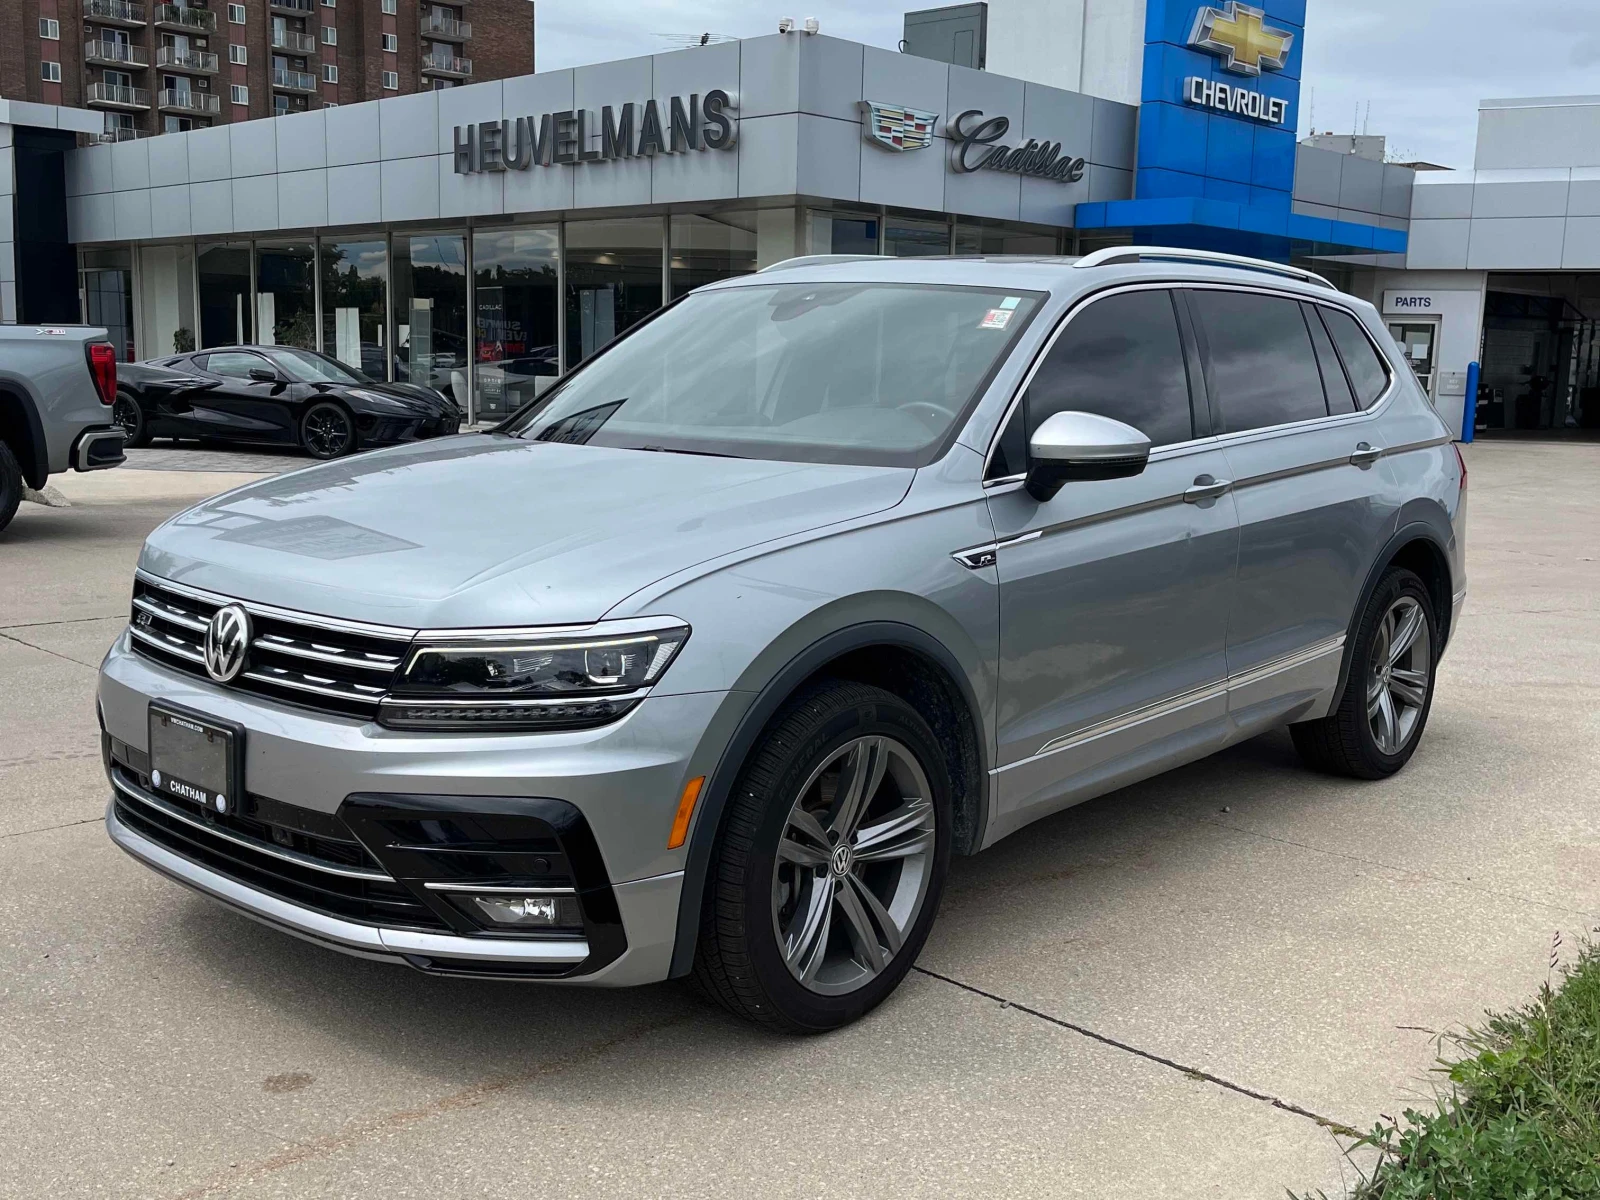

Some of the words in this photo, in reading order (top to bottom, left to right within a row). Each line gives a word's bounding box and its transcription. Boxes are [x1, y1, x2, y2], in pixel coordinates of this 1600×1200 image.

[1190, 76, 1289, 124] CHEVROLET
[453, 89, 738, 175] HEUVELMANS
[949, 109, 1085, 183] Cadillac
[1395, 296, 1431, 308] PARTS
[170, 780, 207, 804] CHATHAM
[778, 732, 831, 799] GENERAL
